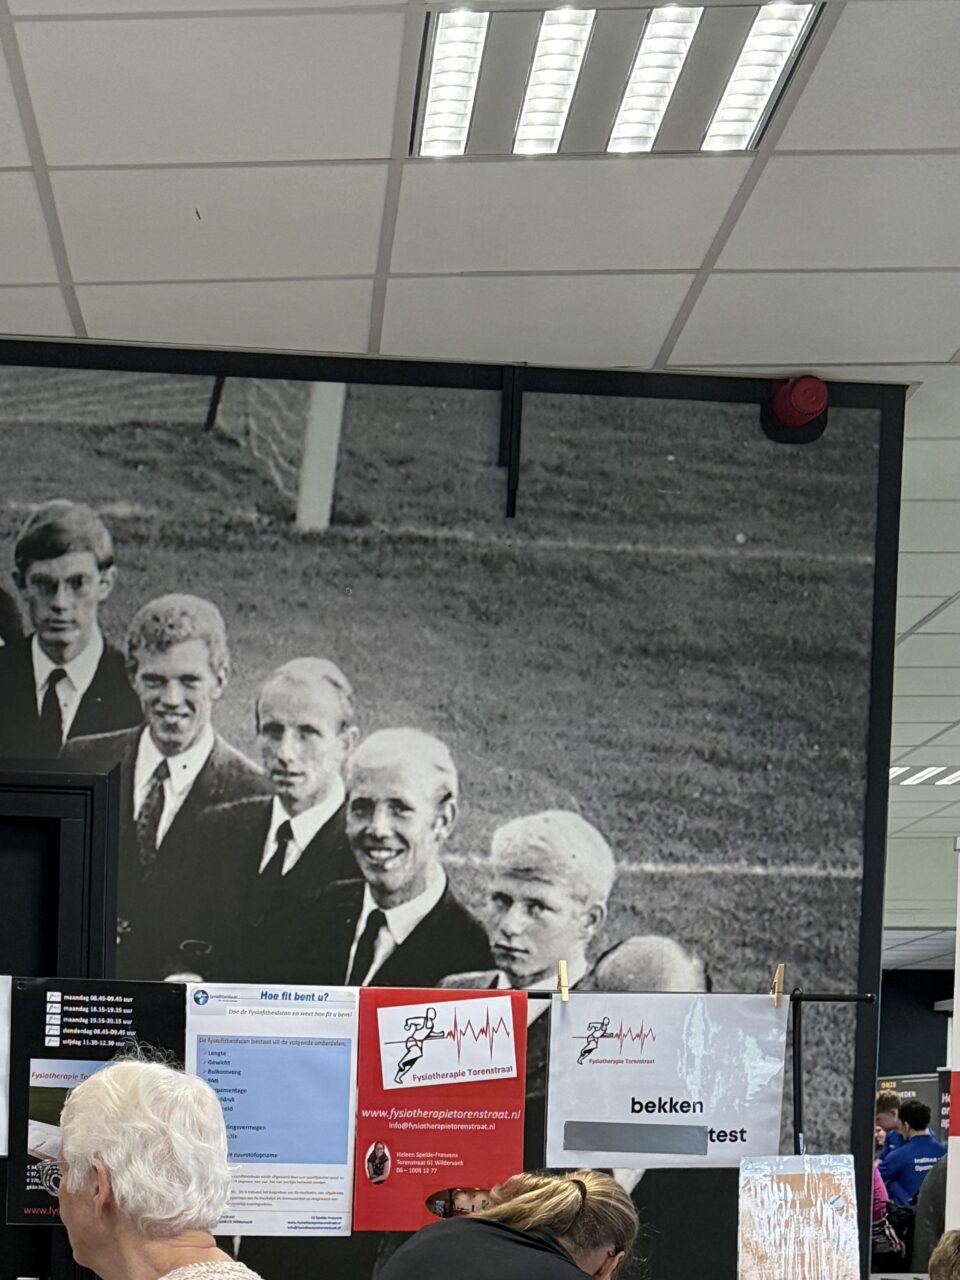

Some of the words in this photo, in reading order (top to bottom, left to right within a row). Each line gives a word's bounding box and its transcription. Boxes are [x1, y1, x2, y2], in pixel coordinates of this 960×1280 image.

[260, 991, 279, 1000] Hoe
[281, 991, 292, 1001] fit
[294, 992, 315, 1001] bent
[318, 992, 329, 1002] u?
[31, 1071, 79, 1081] Fysiotherapie
[412, 1069, 466, 1082] Fysiotherapie
[468, 1065, 513, 1077] Torenstraat
[630, 1096, 704, 1114] bekken
[361, 1107, 521, 1120] www.fysiotherapietorenstraat.nl
[388, 1121, 496, 1131] info@fysiotherapietorenstraat.nl
